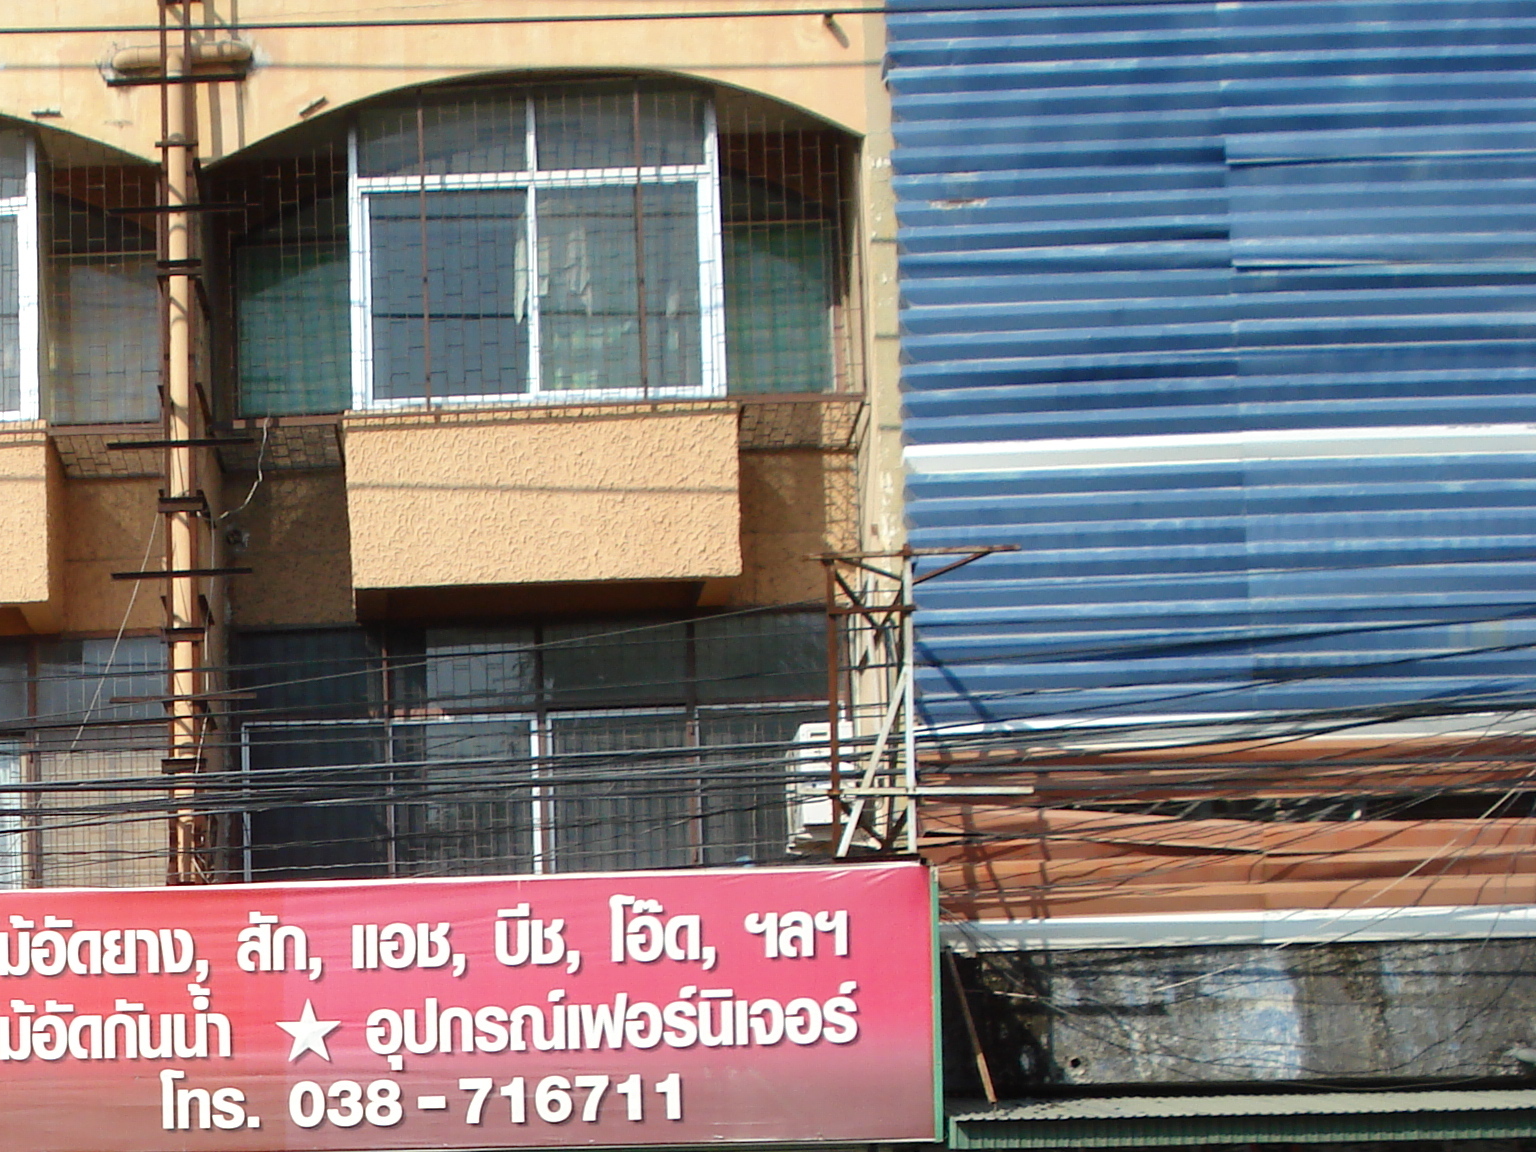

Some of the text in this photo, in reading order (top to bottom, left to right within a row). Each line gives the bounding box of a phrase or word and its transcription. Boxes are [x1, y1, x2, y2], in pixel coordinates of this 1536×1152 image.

[237, 911, 322, 980] สัก,
[352, 921, 465, 977] แอช,
[495, 903, 580, 974] บีช,
[610, 895, 716, 970] โอ๊ด,
[745, 909, 849, 959] ฯลฯ
[366, 981, 858, 1071] อุปกรณ์เฟอร์นิเจอร์
[160, 1070, 261, 1130] โทร.
[459, 1073, 682, 1125] 716711
